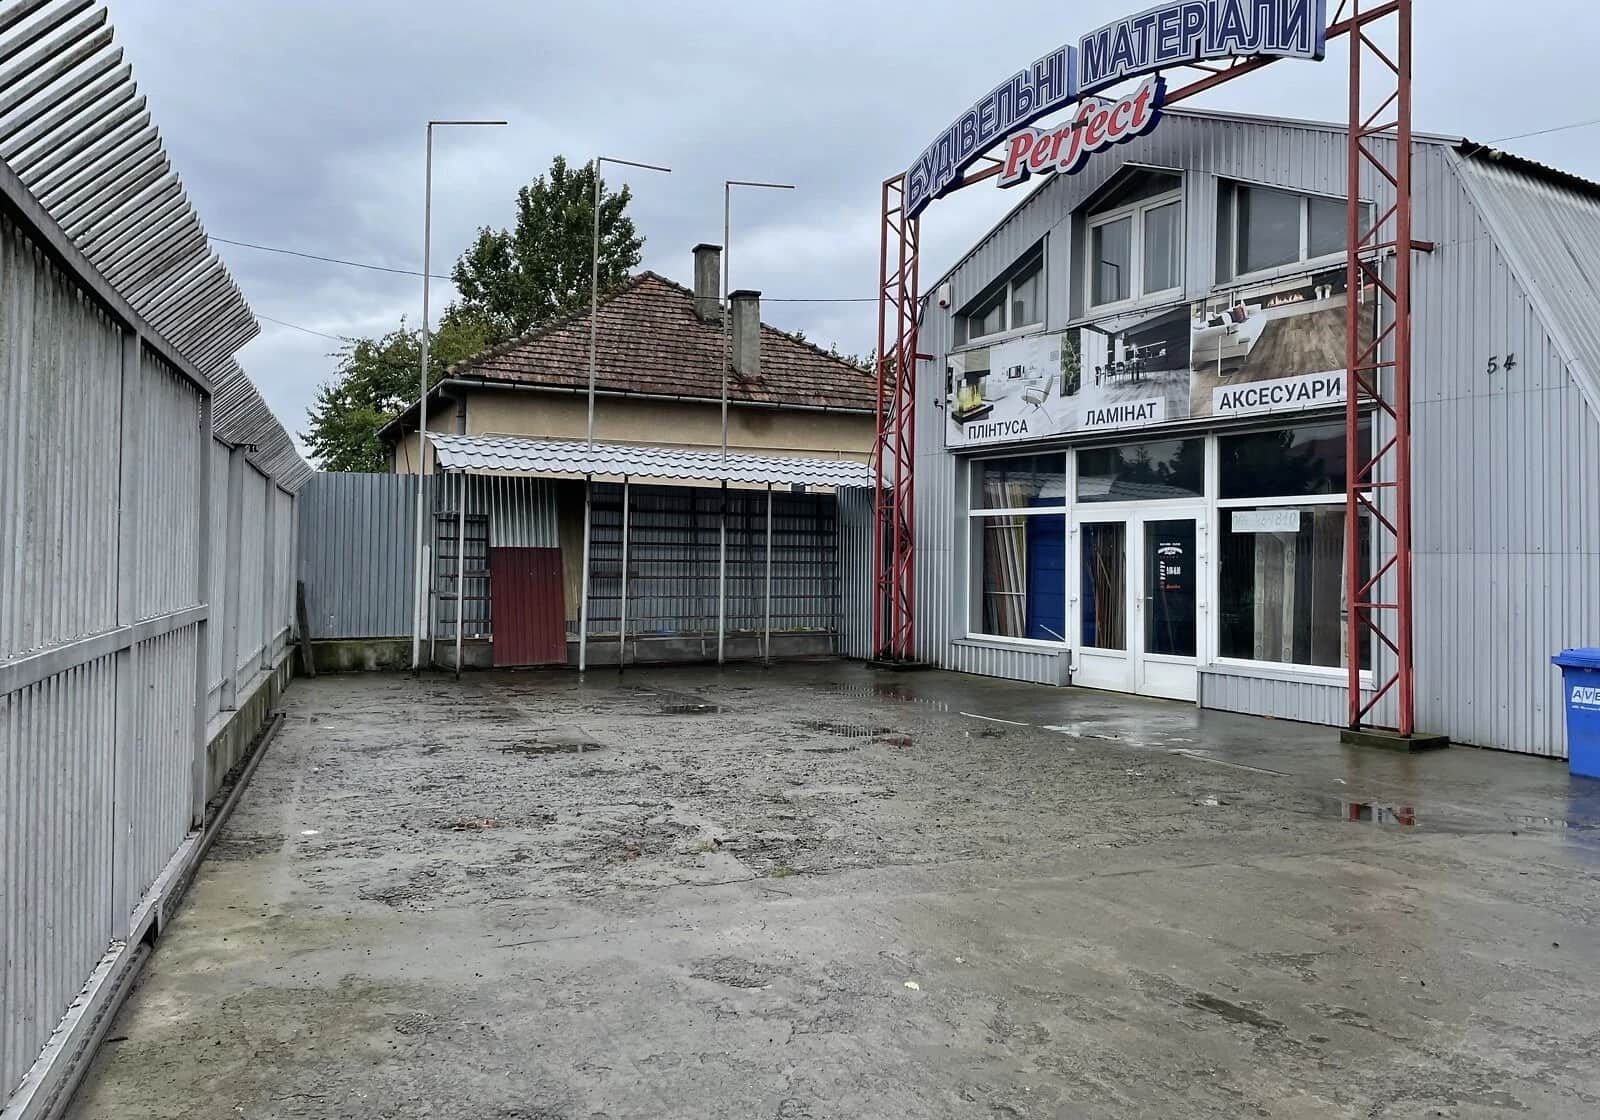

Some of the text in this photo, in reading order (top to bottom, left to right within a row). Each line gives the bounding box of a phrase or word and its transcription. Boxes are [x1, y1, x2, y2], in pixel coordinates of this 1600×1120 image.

[906, 0, 1310, 215] БУДІВЕЛЬНІ МАТЕРІАЛИ
[1002, 84, 1151, 180] Perfect
[1219, 378, 1342, 411] АКСЕСУАРИ
[967, 419, 1029, 440] ПЛІНТУСА
[1085, 402, 1157, 427] ЛАМІНАТ
